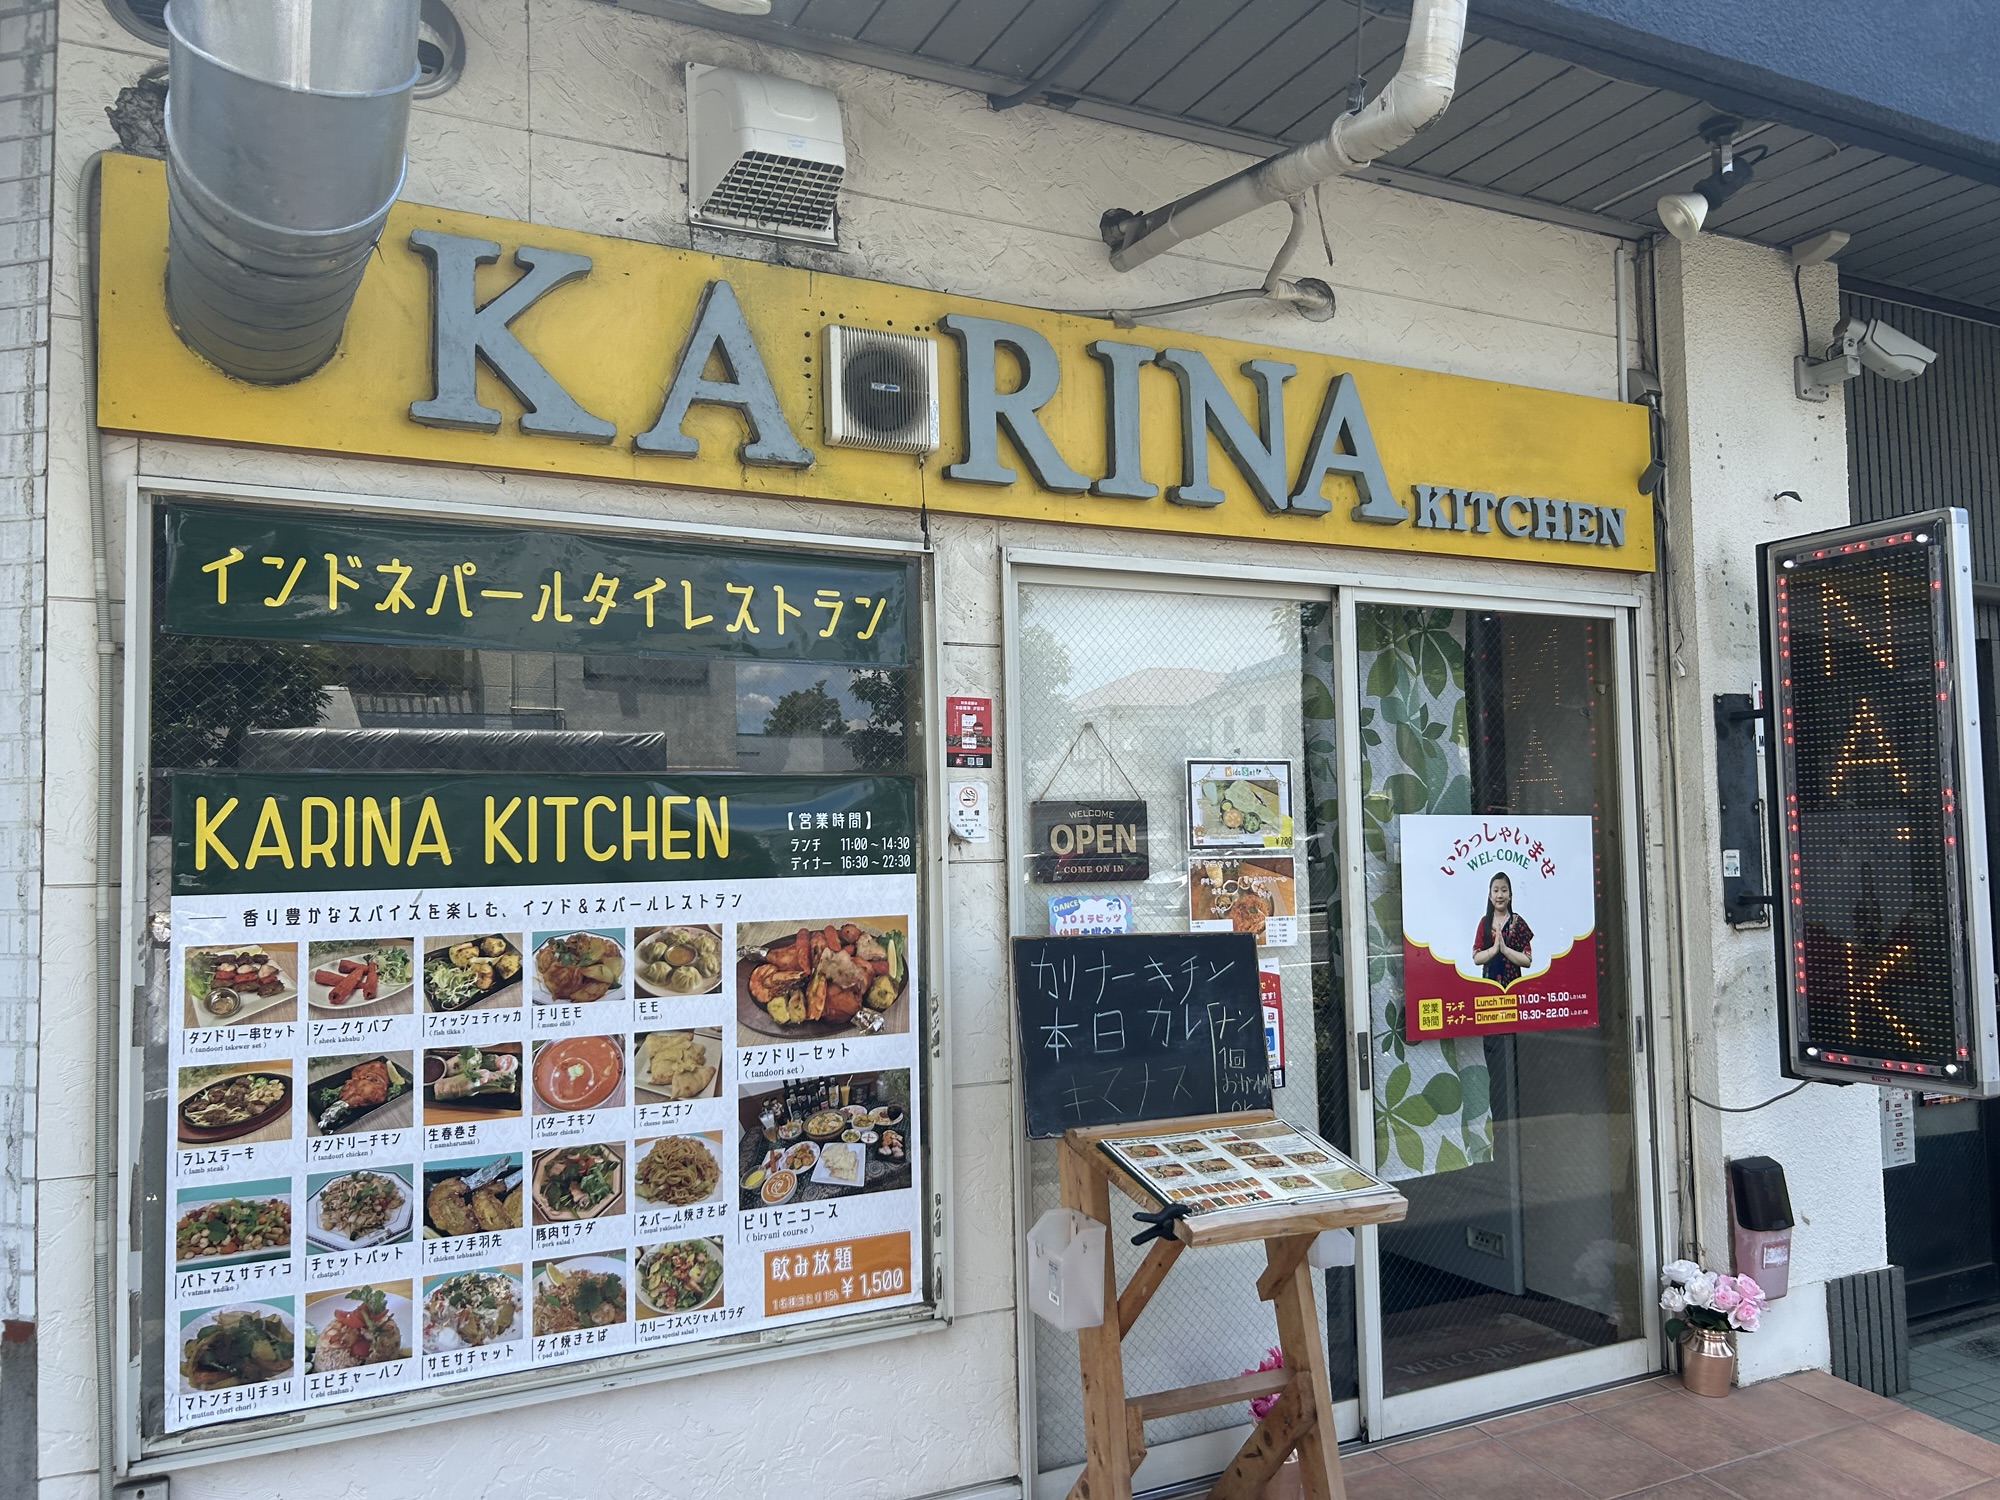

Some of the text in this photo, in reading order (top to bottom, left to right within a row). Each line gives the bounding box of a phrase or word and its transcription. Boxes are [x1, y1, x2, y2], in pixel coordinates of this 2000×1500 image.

[407, 228, 1407, 523] KARINA
[1413, 483, 1626, 548] KITCHEN
[203, 547, 887, 640] インドネパールタイレストラン
[1069, 809, 1115, 820] WELCOME
[195, 796, 730, 871] KARINA KITCHEN
[1050, 823, 1137, 855] OPEN
[790, 838, 822, 852] ランチ
[1440, 822, 1557, 880] いらっしゃいませ
[790, 857, 832, 870] ディナー
[1063, 864, 1124, 873] COME ON IN
[1466, 848, 1531, 872] WEL-COME
[1053, 900, 1080, 912] DANCE
[537, 1006, 582, 1021] チリモモ
[639, 1001, 658, 1013] モモ
[1422, 1003, 1440, 1015] 営業
[1445, 1001, 1465, 1012] ランチ
[1475, 998, 1498, 1007] Lunch
[1499, 997, 1516, 1006] Time
[313, 1019, 394, 1037] シークケバブ
[428, 1010, 522, 1027] フィッシュティッカ
[1422, 1015, 1440, 1027] 時間
[1446, 1015, 1473, 1025] ディナー
[1476, 1013, 1499, 1022] Dinner
[1500, 1012, 1516, 1021] Time
[189, 1025, 295, 1044] タンドリー串セット
[743, 1042, 850, 1066] タンドリーセット
[536, 1113, 596, 1130] バターチキン
[639, 1104, 693, 1120] チーズナン
[312, 1132, 402, 1153] タンドリーチキン
[428, 1125, 477, 1142] 生春巻き
[640, 1204, 728, 1228] ネパール焼きそば
[744, 1203, 838, 1230] ビリヤニコース
[536, 1221, 597, 1241] 豚肉サラダ
[428, 1234, 502, 1256] チキン手羽先
[771, 1246, 853, 1282] 飲み放題
[640, 1306, 745, 1333] カリーナスペシャルサラダ
[537, 1328, 609, 1352] タイ焼きそば
[428, 1344, 514, 1369] サモサチャット
[310, 1363, 404, 1391] エビチャーハン
[185, 1381, 292, 1411] マトンチョリチョリ
